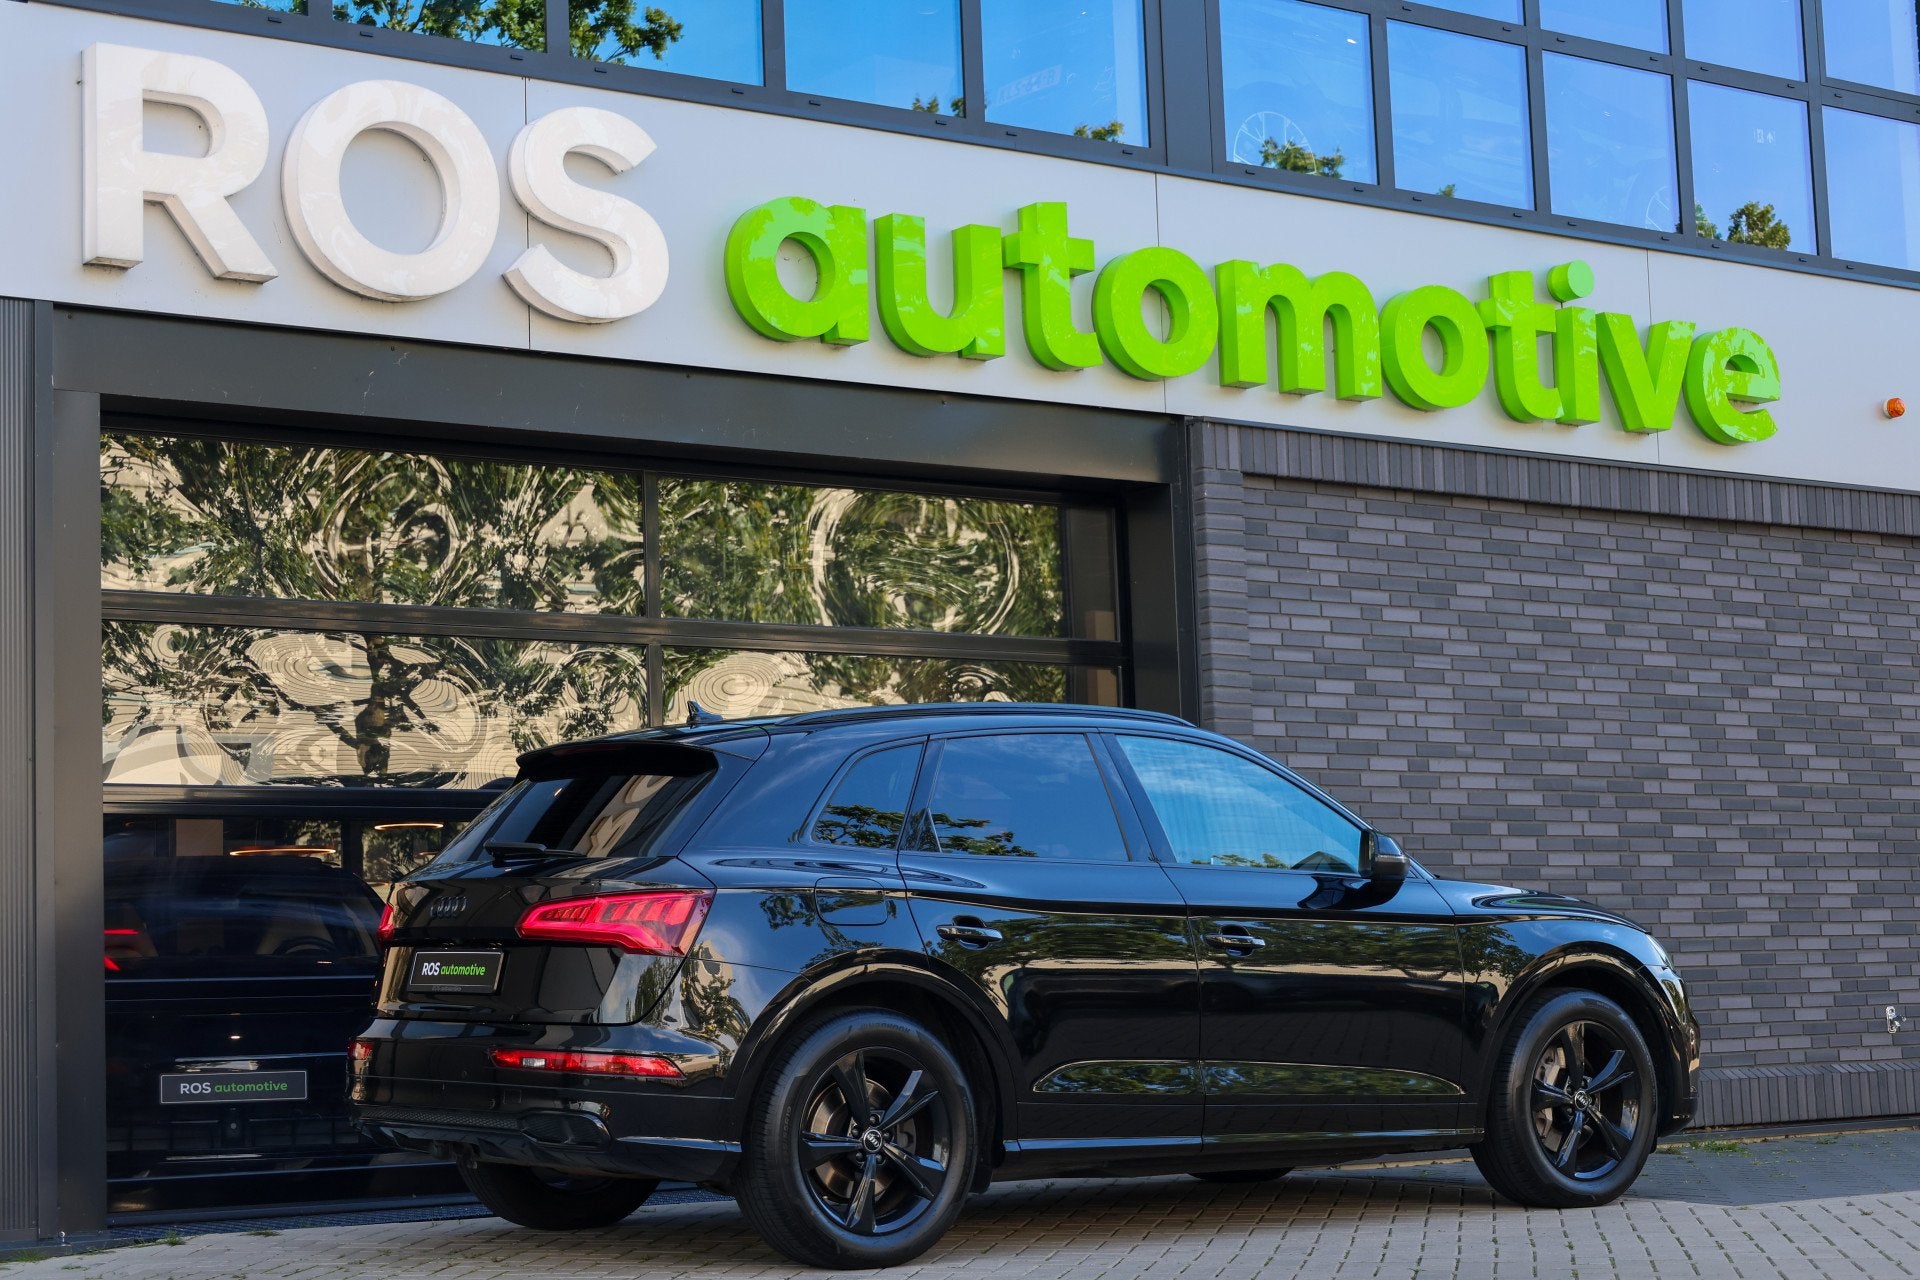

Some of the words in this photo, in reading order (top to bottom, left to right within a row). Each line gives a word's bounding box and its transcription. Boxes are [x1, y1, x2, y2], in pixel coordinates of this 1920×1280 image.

[82, 41, 670, 324] ROS
[723, 195, 1781, 446] automotive
[421, 962, 440, 976] ROS
[440, 963, 486, 976] automotive
[180, 1082, 212, 1095] ROS
[214, 1081, 288, 1093] automotive
